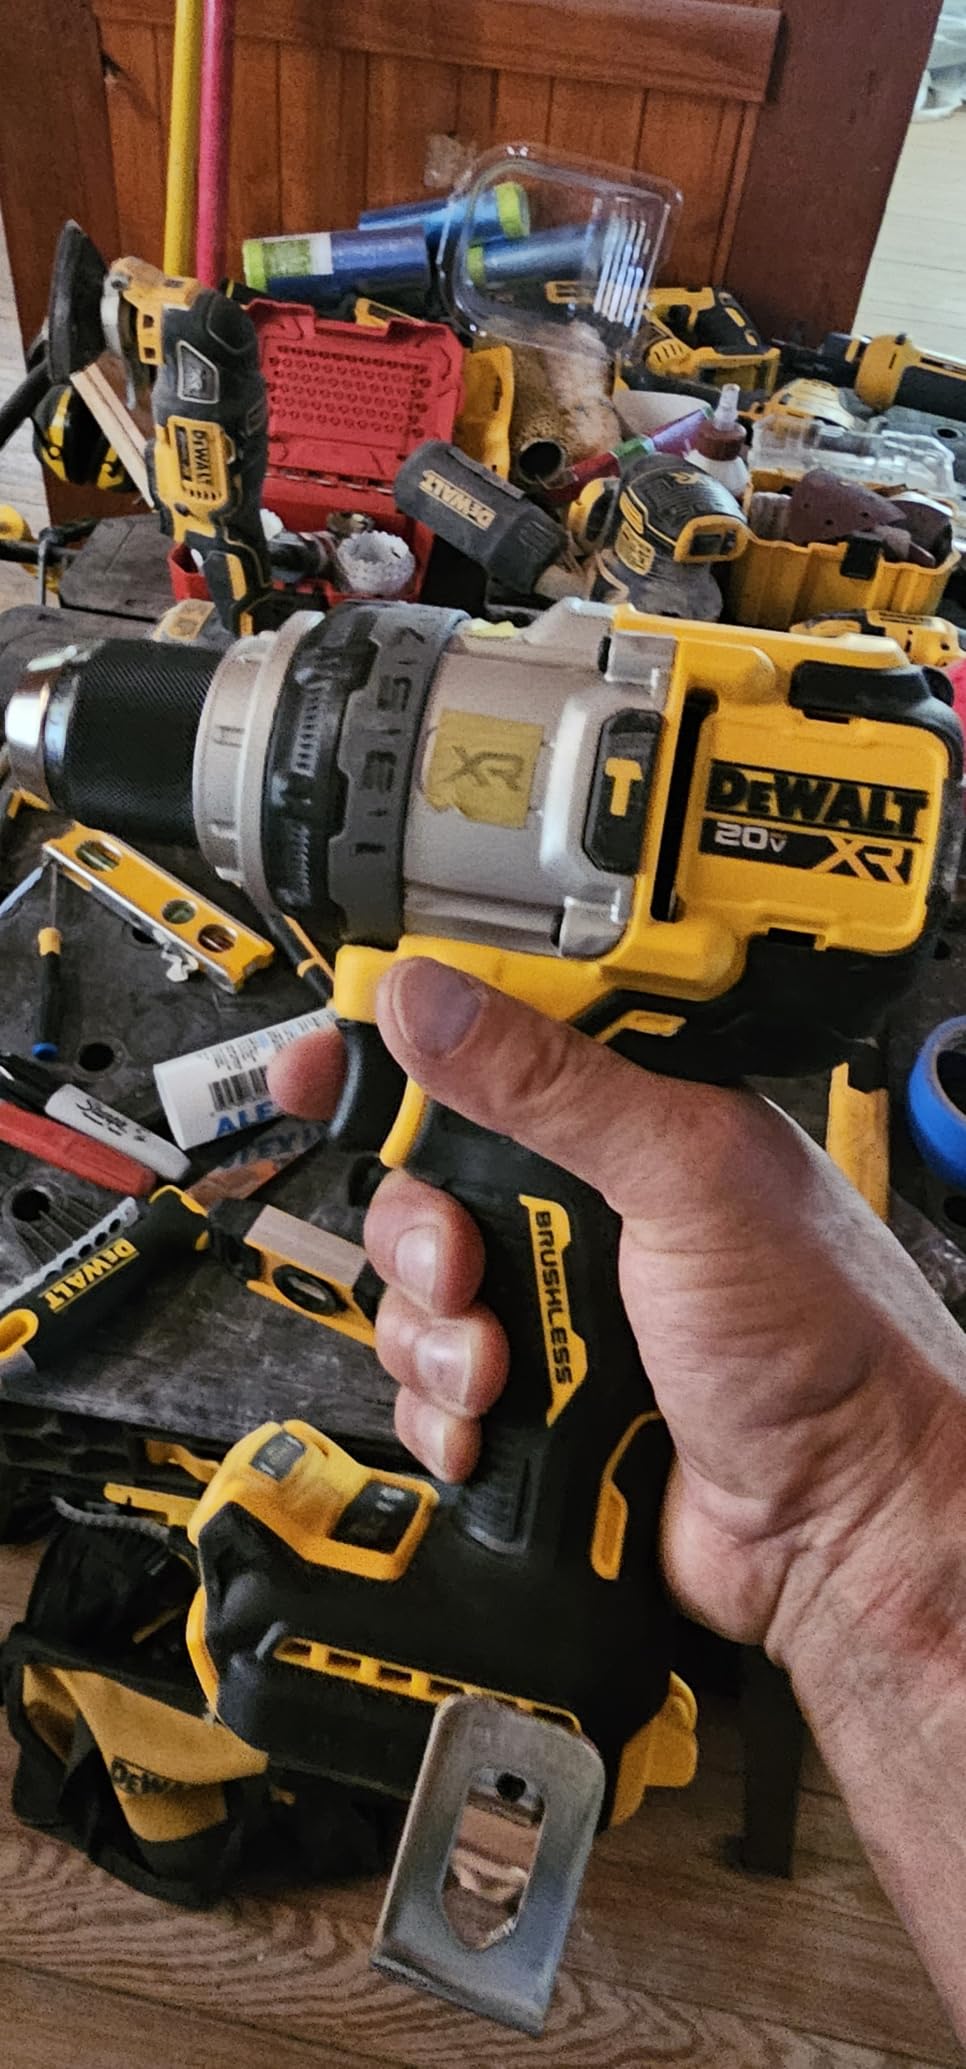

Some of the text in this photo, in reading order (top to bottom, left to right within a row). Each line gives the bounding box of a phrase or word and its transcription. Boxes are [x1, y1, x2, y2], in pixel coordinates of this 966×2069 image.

[192, 429, 214, 487] DEWALT
[419, 472, 495, 529] DEWALT
[440, 745, 525, 792] XR
[704, 762, 930, 839] DEWALT
[810, 834, 908, 886] XR
[214, 1100, 274, 1139] ALE
[43, 1237, 137, 1311] DEWALT
[535, 1210, 574, 1385] BRUSHLESS
